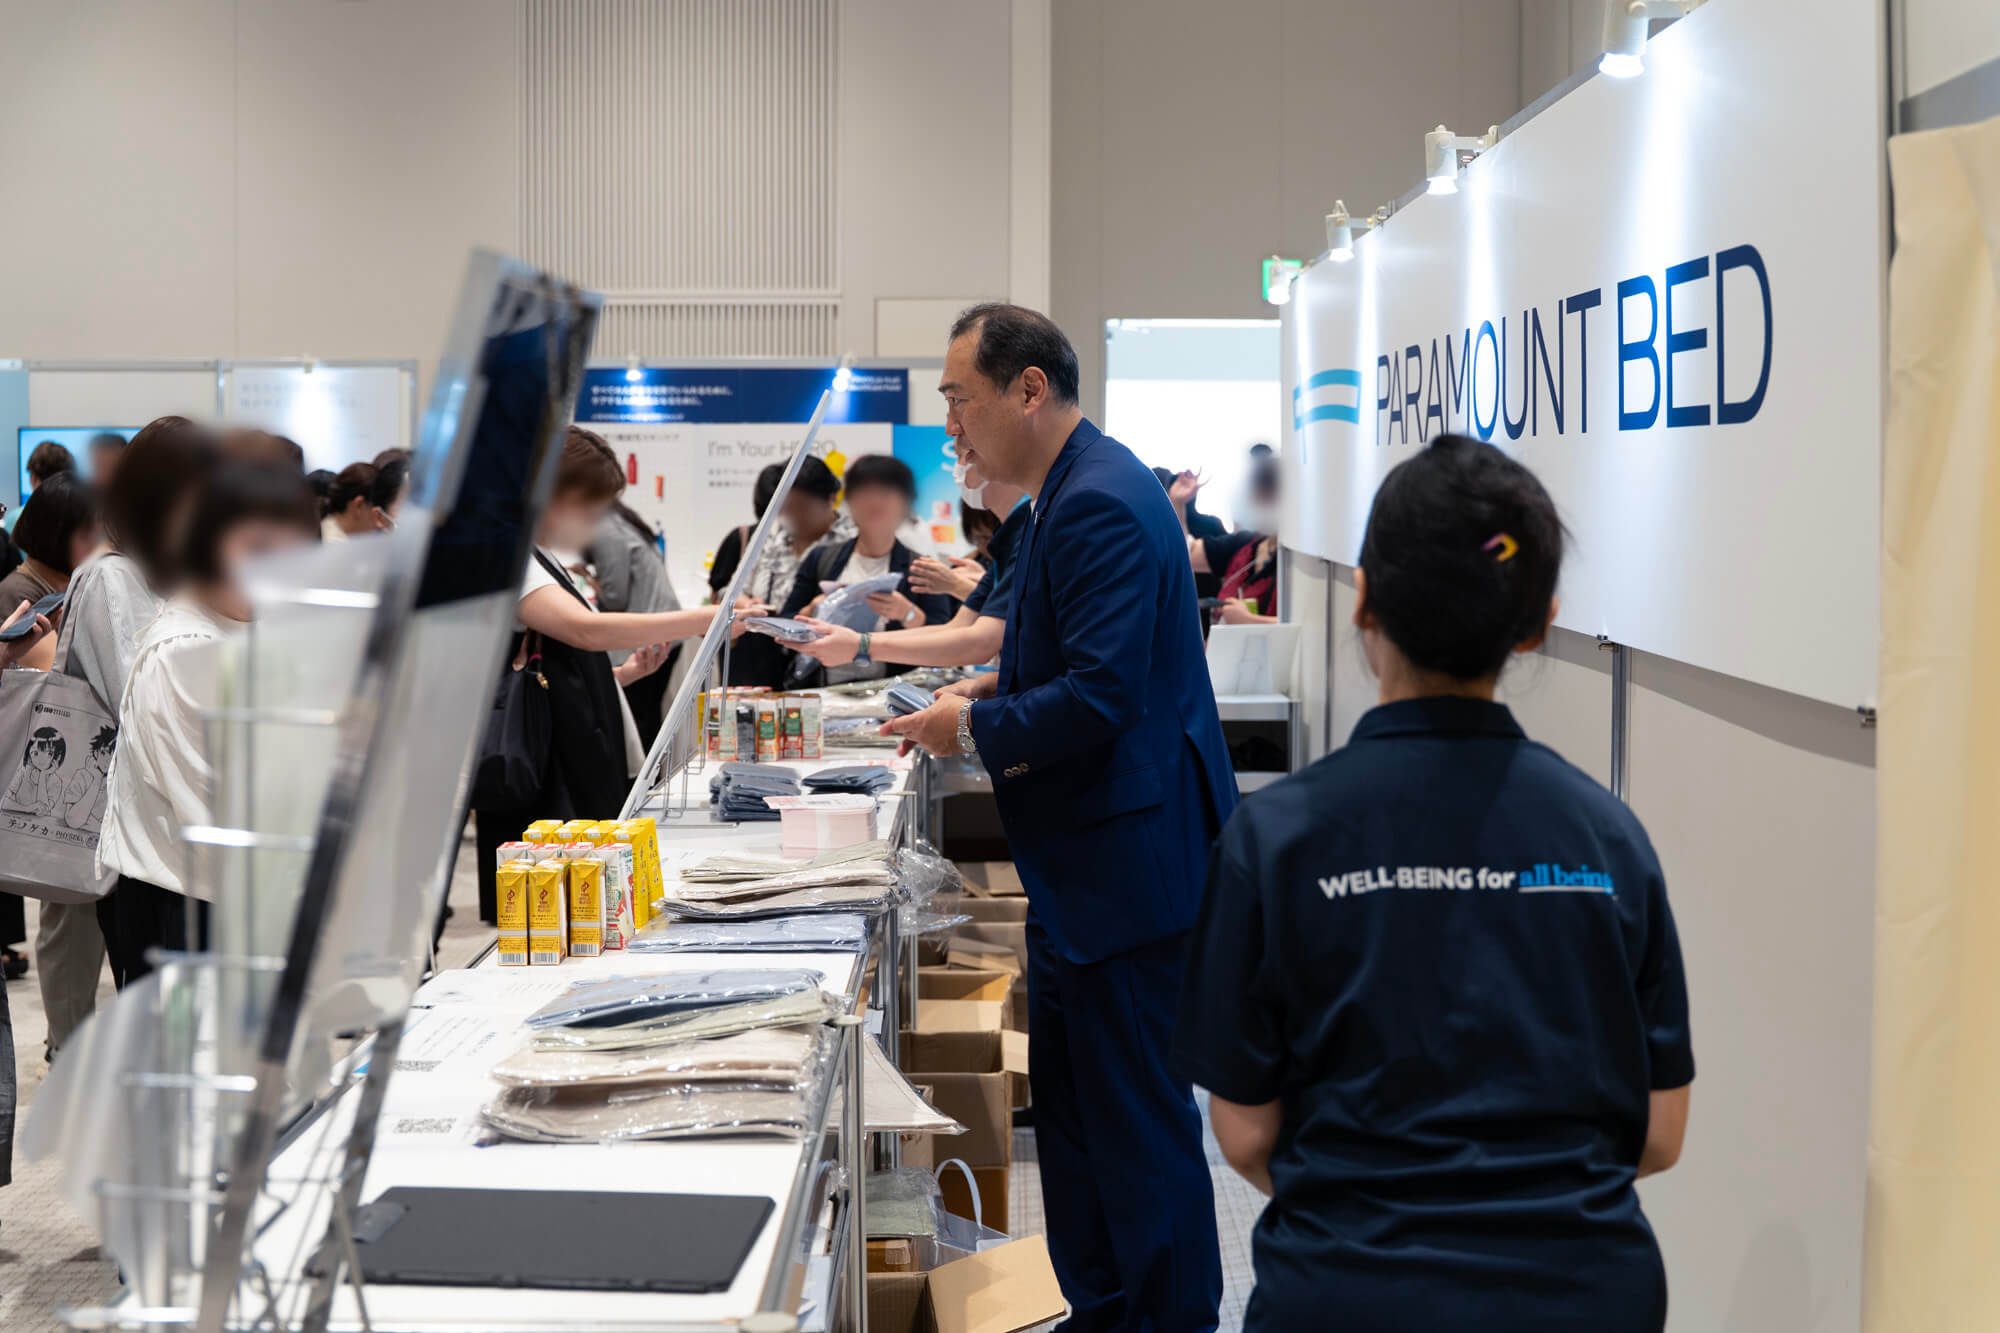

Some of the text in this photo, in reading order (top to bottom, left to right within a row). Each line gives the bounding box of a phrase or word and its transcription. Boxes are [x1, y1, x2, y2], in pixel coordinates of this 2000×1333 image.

[1376, 244, 1773, 447] PARAMOUNT BED
[736, 439, 776, 457] Your
[1476, 866, 1516, 889] for
[1519, 863, 1550, 887] all
